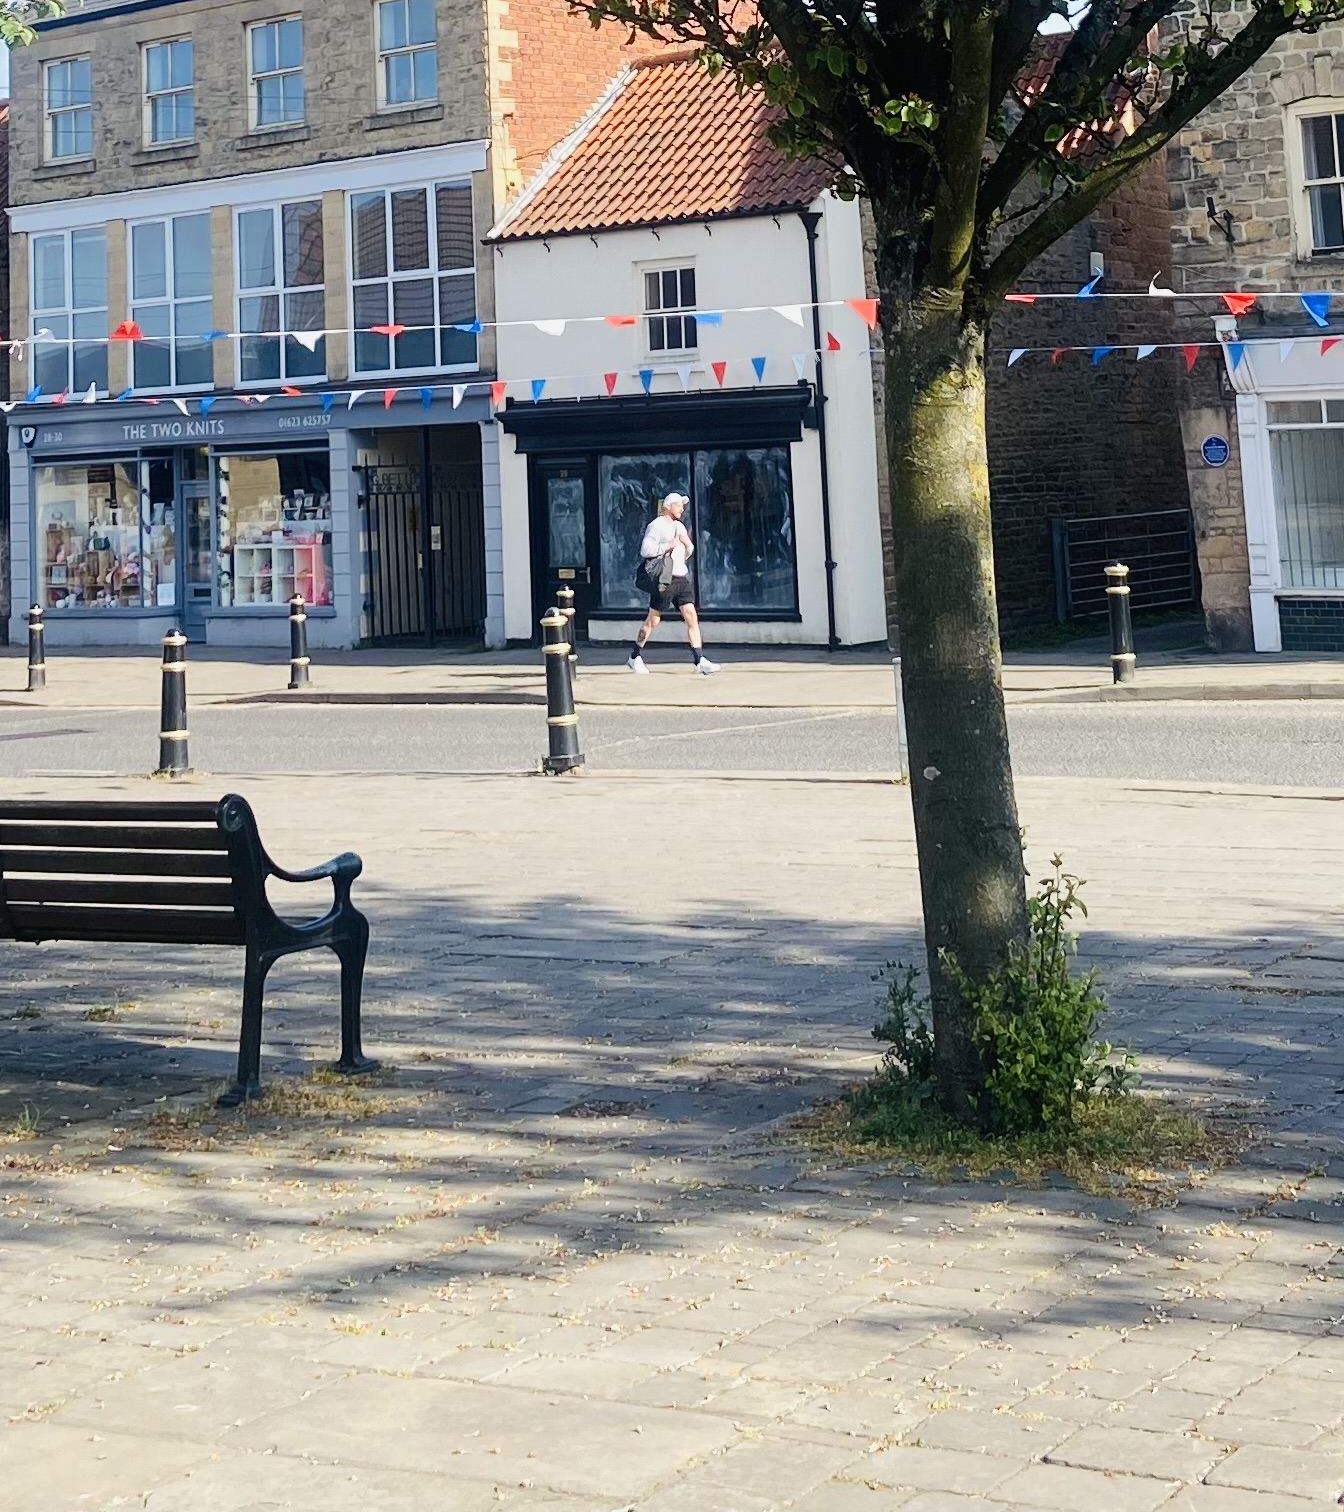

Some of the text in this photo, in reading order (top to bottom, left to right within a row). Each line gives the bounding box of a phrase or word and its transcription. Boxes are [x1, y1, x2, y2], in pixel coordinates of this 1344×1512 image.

[123, 419, 225, 440] THE TWO KNITS
[278, 414, 332, 428] 01623 625757
